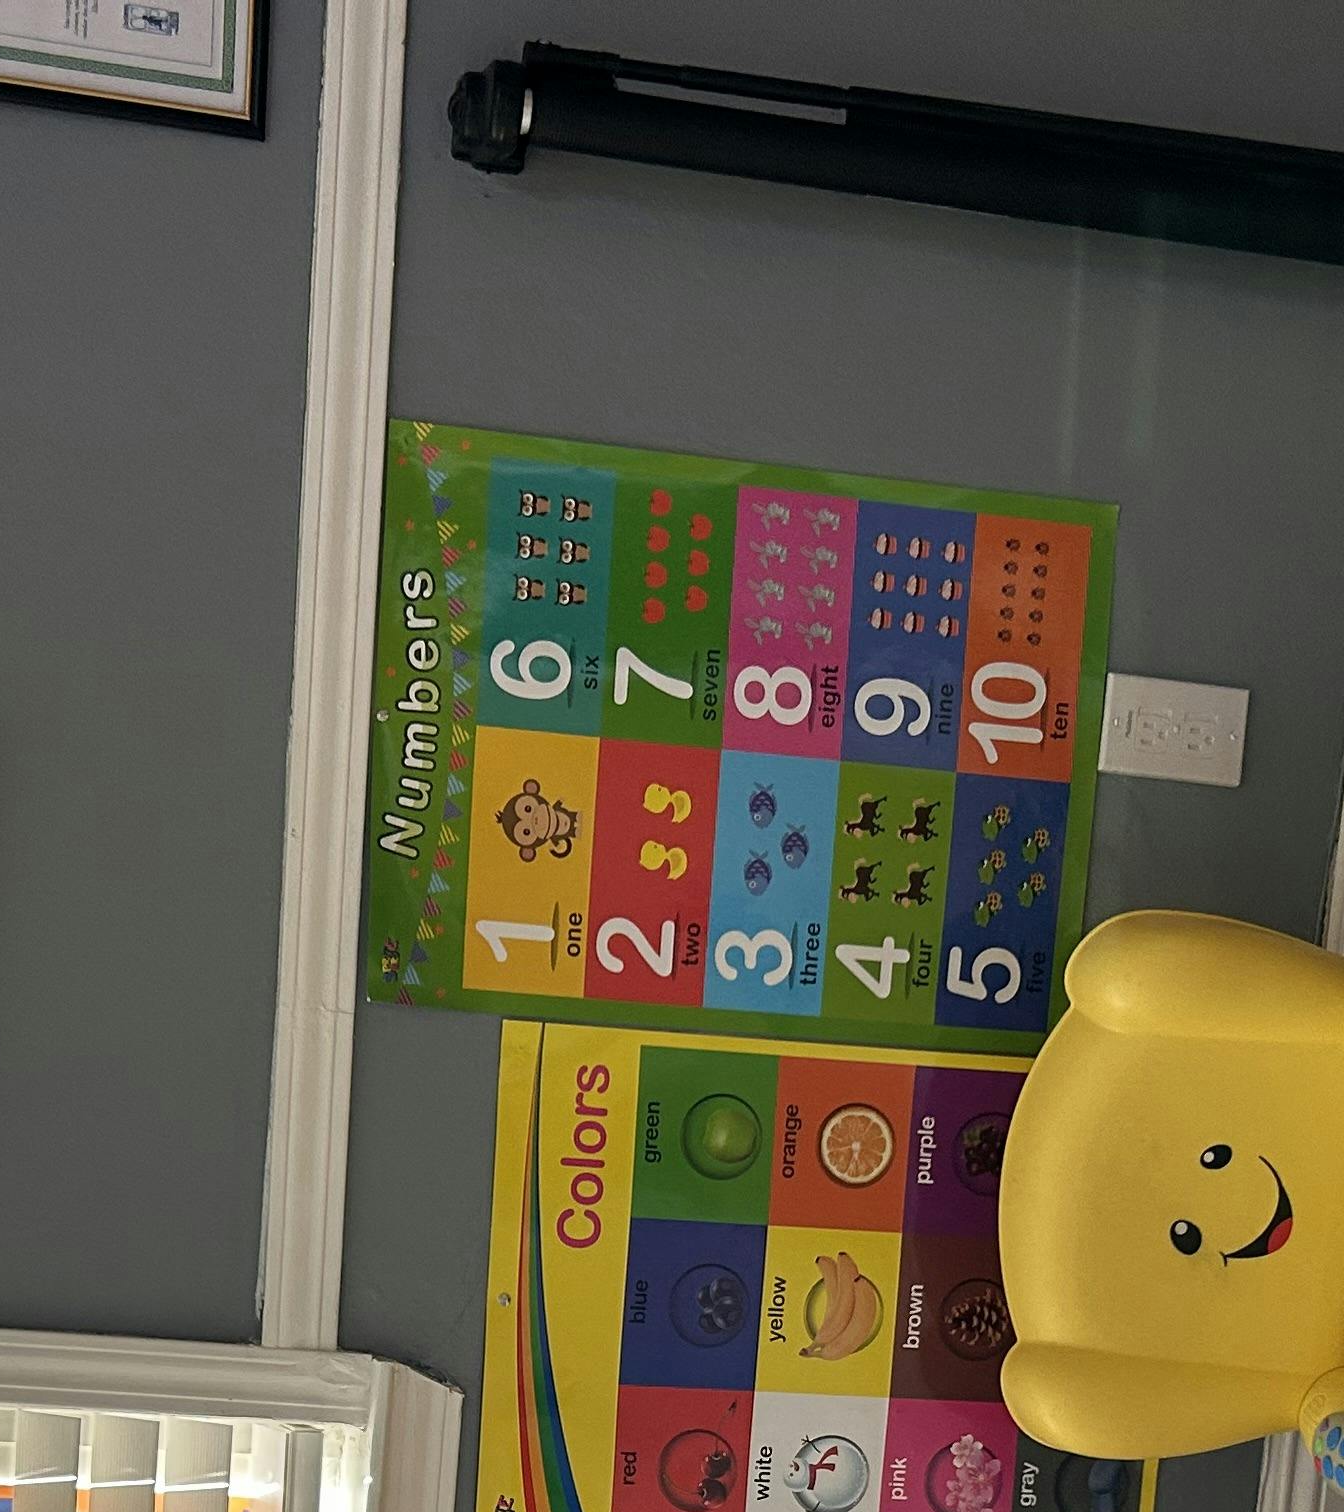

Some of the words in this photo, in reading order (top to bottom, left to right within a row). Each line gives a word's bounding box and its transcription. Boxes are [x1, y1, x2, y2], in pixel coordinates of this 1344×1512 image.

[490, 638, 572, 701] 6
[581, 655, 600, 690] six
[613, 646, 694, 705] 7
[700, 648, 722, 722] seven
[733, 664, 812, 725] 8
[818, 665, 841, 729] eight
[377, 568, 442, 859] Numbers
[854, 677, 931, 736] 9
[935, 683, 954, 736] nine
[968, 661, 1047, 765] 10
[1050, 702, 1070, 740] ten
[475, 919, 555, 963] 1
[564, 912, 584, 958] one
[595, 916, 675, 978] 2
[682, 922, 702, 966] two
[714, 929, 793, 986] 3
[799, 922, 821, 986] three
[913, 939, 933, 989] four
[835, 935, 911, 999] 4
[946, 945, 1021, 1005] 5
[1027, 951, 1047, 995] five
[557, 1064, 610, 1249] Colors
[643, 1101, 662, 1164] green
[780, 1104, 801, 1179] orange
[916, 1116, 936, 1185] purple
[630, 1280, 649, 1323] blue
[767, 1276, 788, 1343] yellow
[903, 1284, 924, 1349] brown
[621, 1451, 638, 1485] red
[754, 1445, 774, 1501] white
[889, 1458, 908, 1500] pink
[1019, 1462, 1040, 1507] gray
